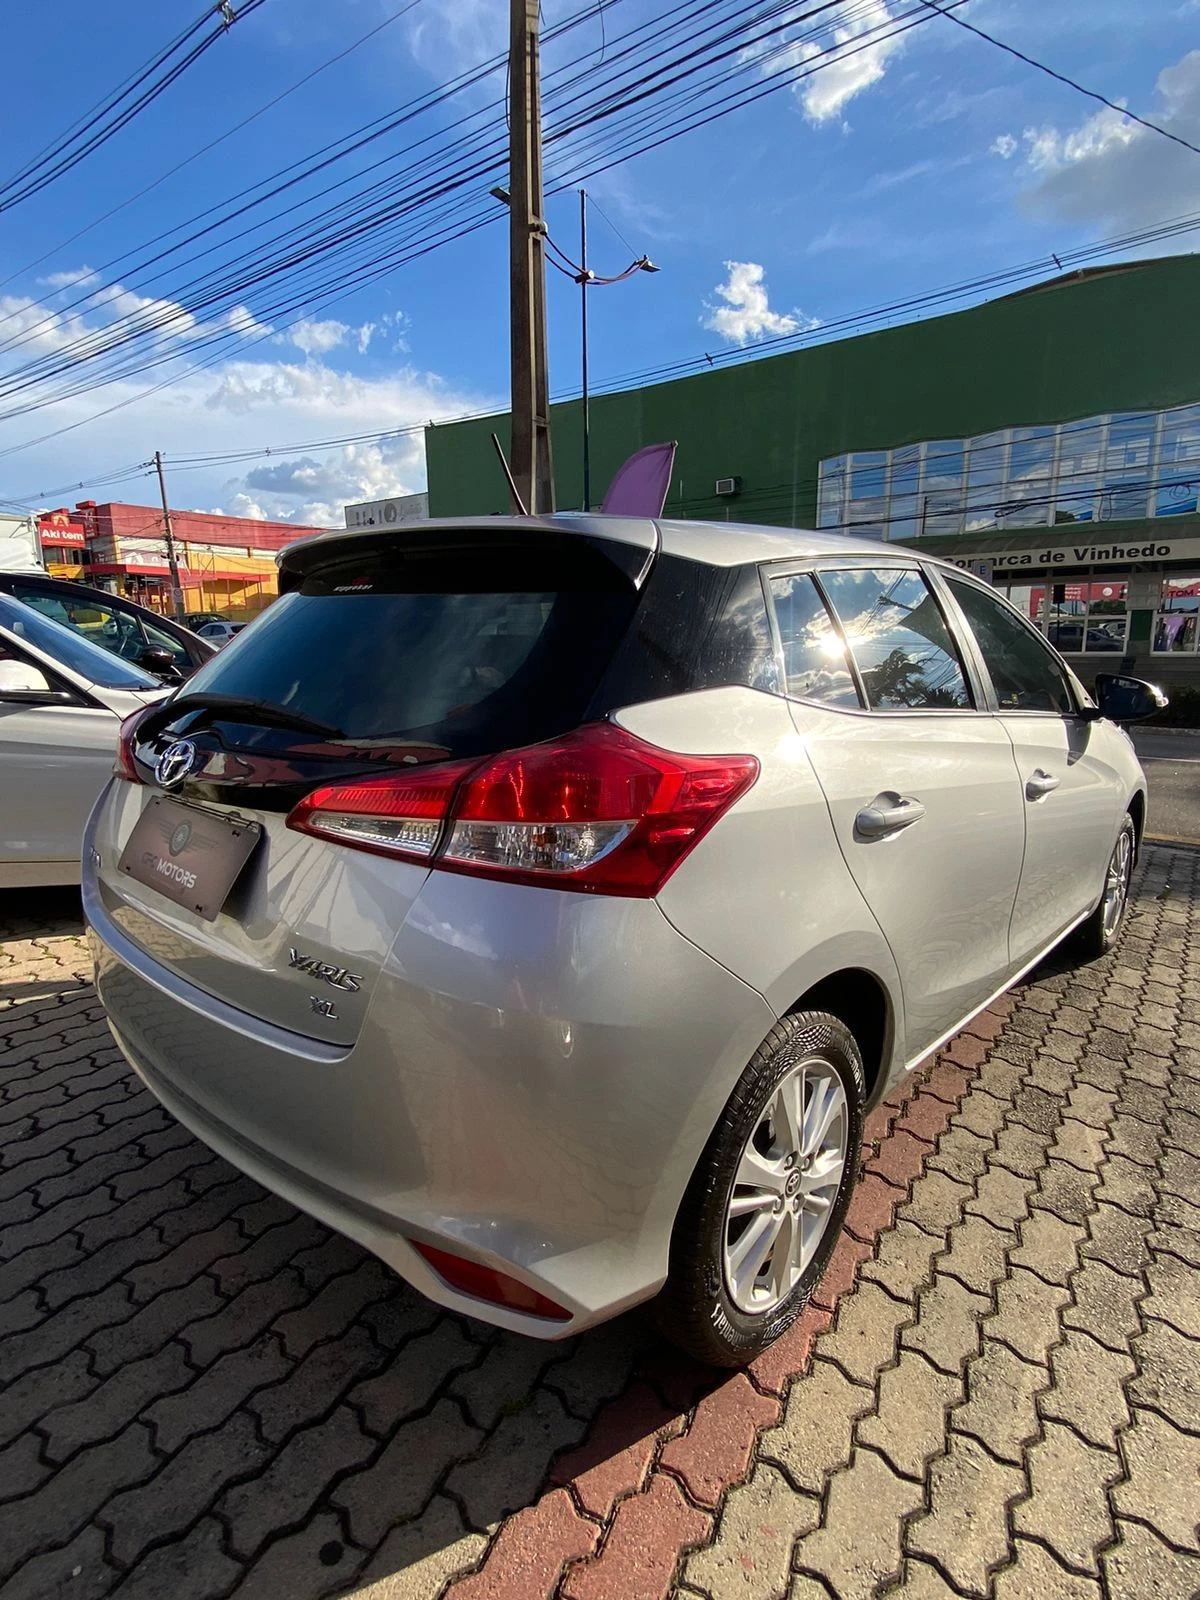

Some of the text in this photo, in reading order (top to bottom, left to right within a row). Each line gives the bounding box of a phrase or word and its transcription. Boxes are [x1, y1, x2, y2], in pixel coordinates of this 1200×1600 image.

[42, 529, 60, 538] Aki
[1039, 550, 1066, 563] de
[1073, 543, 1171, 561] Vinhedo
[980, 565, 987, 574] E
[156, 857, 197, 889] MOTORS
[288, 946, 364, 992] YARIS
[310, 995, 339, 1020] XL
